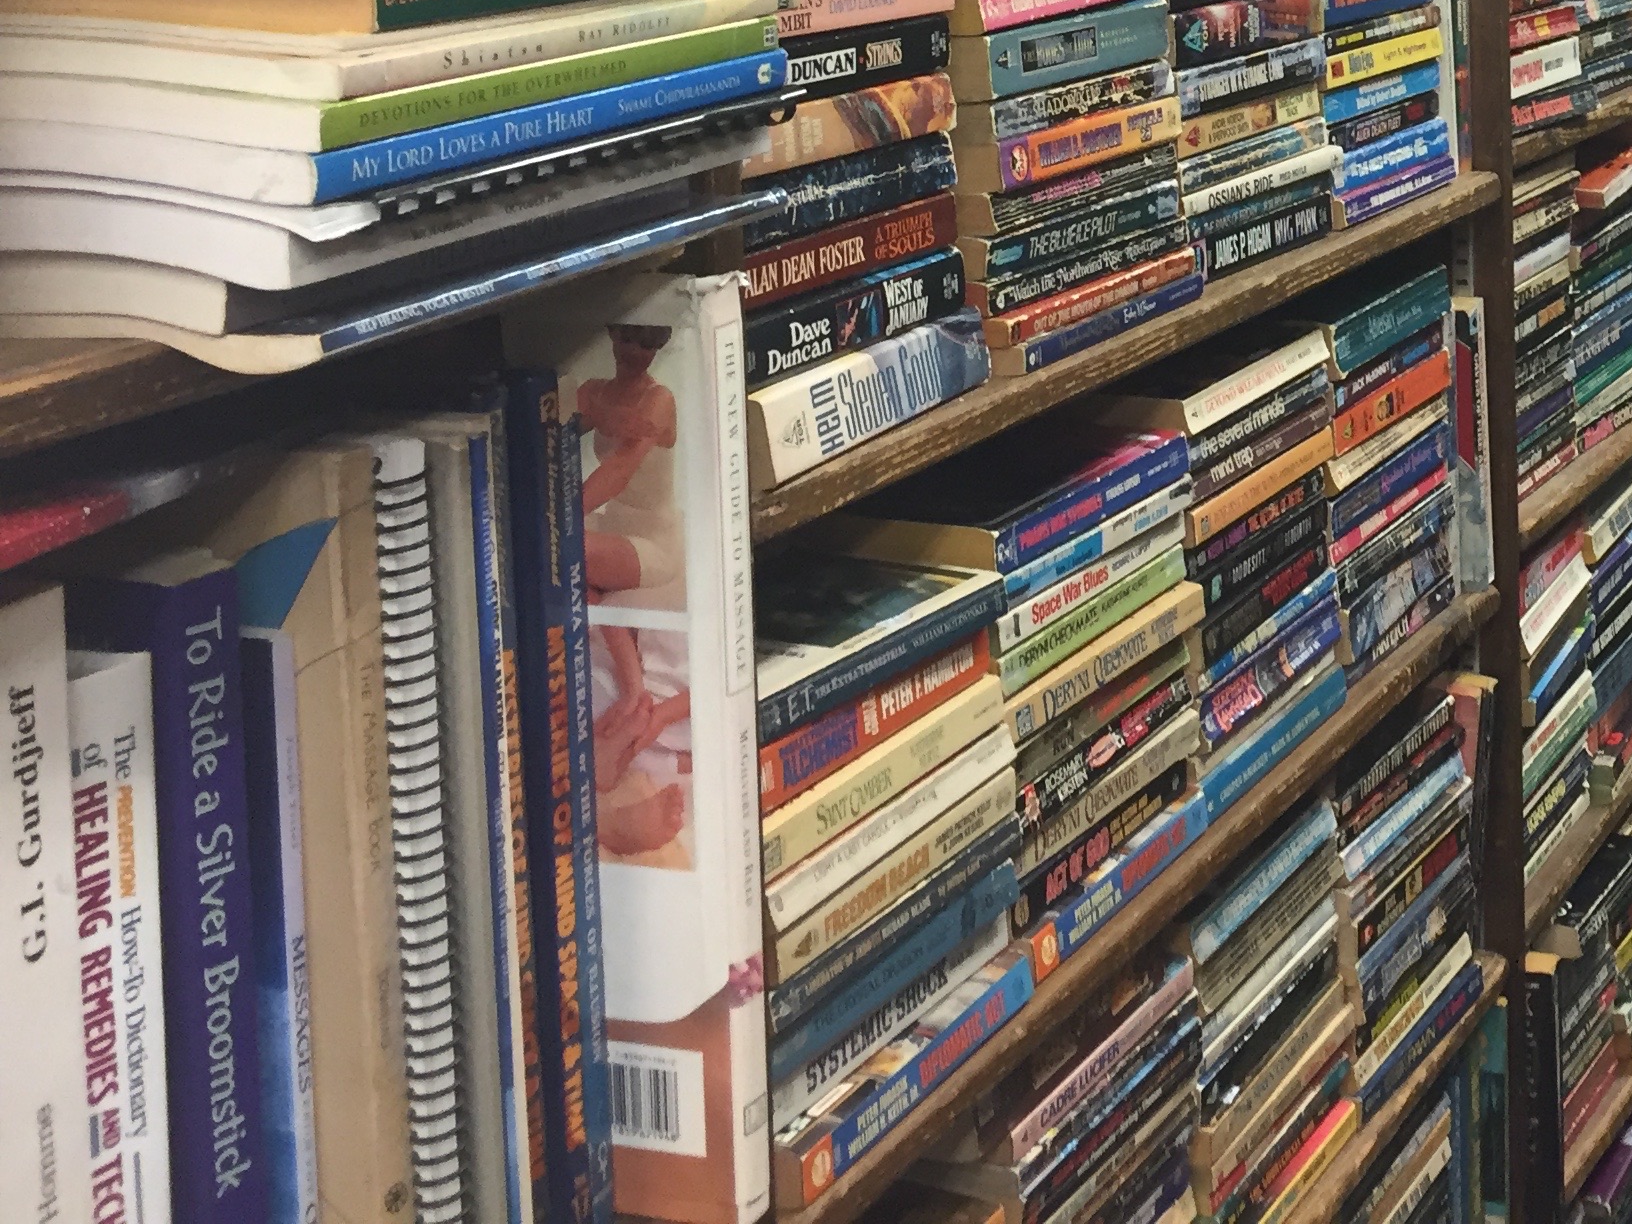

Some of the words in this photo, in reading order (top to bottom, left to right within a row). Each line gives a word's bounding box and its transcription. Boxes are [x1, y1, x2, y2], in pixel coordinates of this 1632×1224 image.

[358, 97, 454, 128] DEVOTIONS
[456, 87, 487, 108] FOR
[490, 80, 522, 101] THE
[524, 58, 628, 95] OVERWHELMED
[790, 51, 856, 83] DUNCAN
[490, 132, 502, 149] A
[743, 265, 779, 300] ALAN
[780, 250, 816, 283] DEAN
[818, 235, 867, 276] FOSTER
[874, 244, 890, 261] OF
[888, 230, 936, 258] SOULS
[1214, 233, 1240, 270] JAMES
[1247, 221, 1273, 257] HOGAN
[883, 279, 914, 309] WEST
[913, 277, 925, 298] OF
[885, 295, 930, 338] JANUARY
[767, 337, 834, 376] Duncan
[788, 317, 832, 349] Dave
[1031, 594, 1062, 626] Space
[1061, 579, 1083, 607] War
[1082, 564, 1110, 594] Blues
[185, 604, 223, 666] To
[1018, 639, 1050, 669] DERYNI
[880, 672, 915, 721] PETER
[922, 641, 975, 696] HAMILTON
[1042, 668, 1092, 726] DERYNI
[82, 741, 110, 772] of
[112, 724, 137, 780] The
[187, 673, 230, 780] Ride
[8, 683, 46, 870] Gurdjieff
[193, 789, 221, 818] a
[71, 779, 115, 941] HEALING
[195, 823, 241, 950] Silver
[79, 944, 121, 1108] REMEDIES
[804, 1004, 895, 1096] SYSTEMIC
[893, 969, 950, 1022] SHOCK
[123, 1006, 150, 1140] Dictionary
[203, 953, 253, 1200] Broomstick
